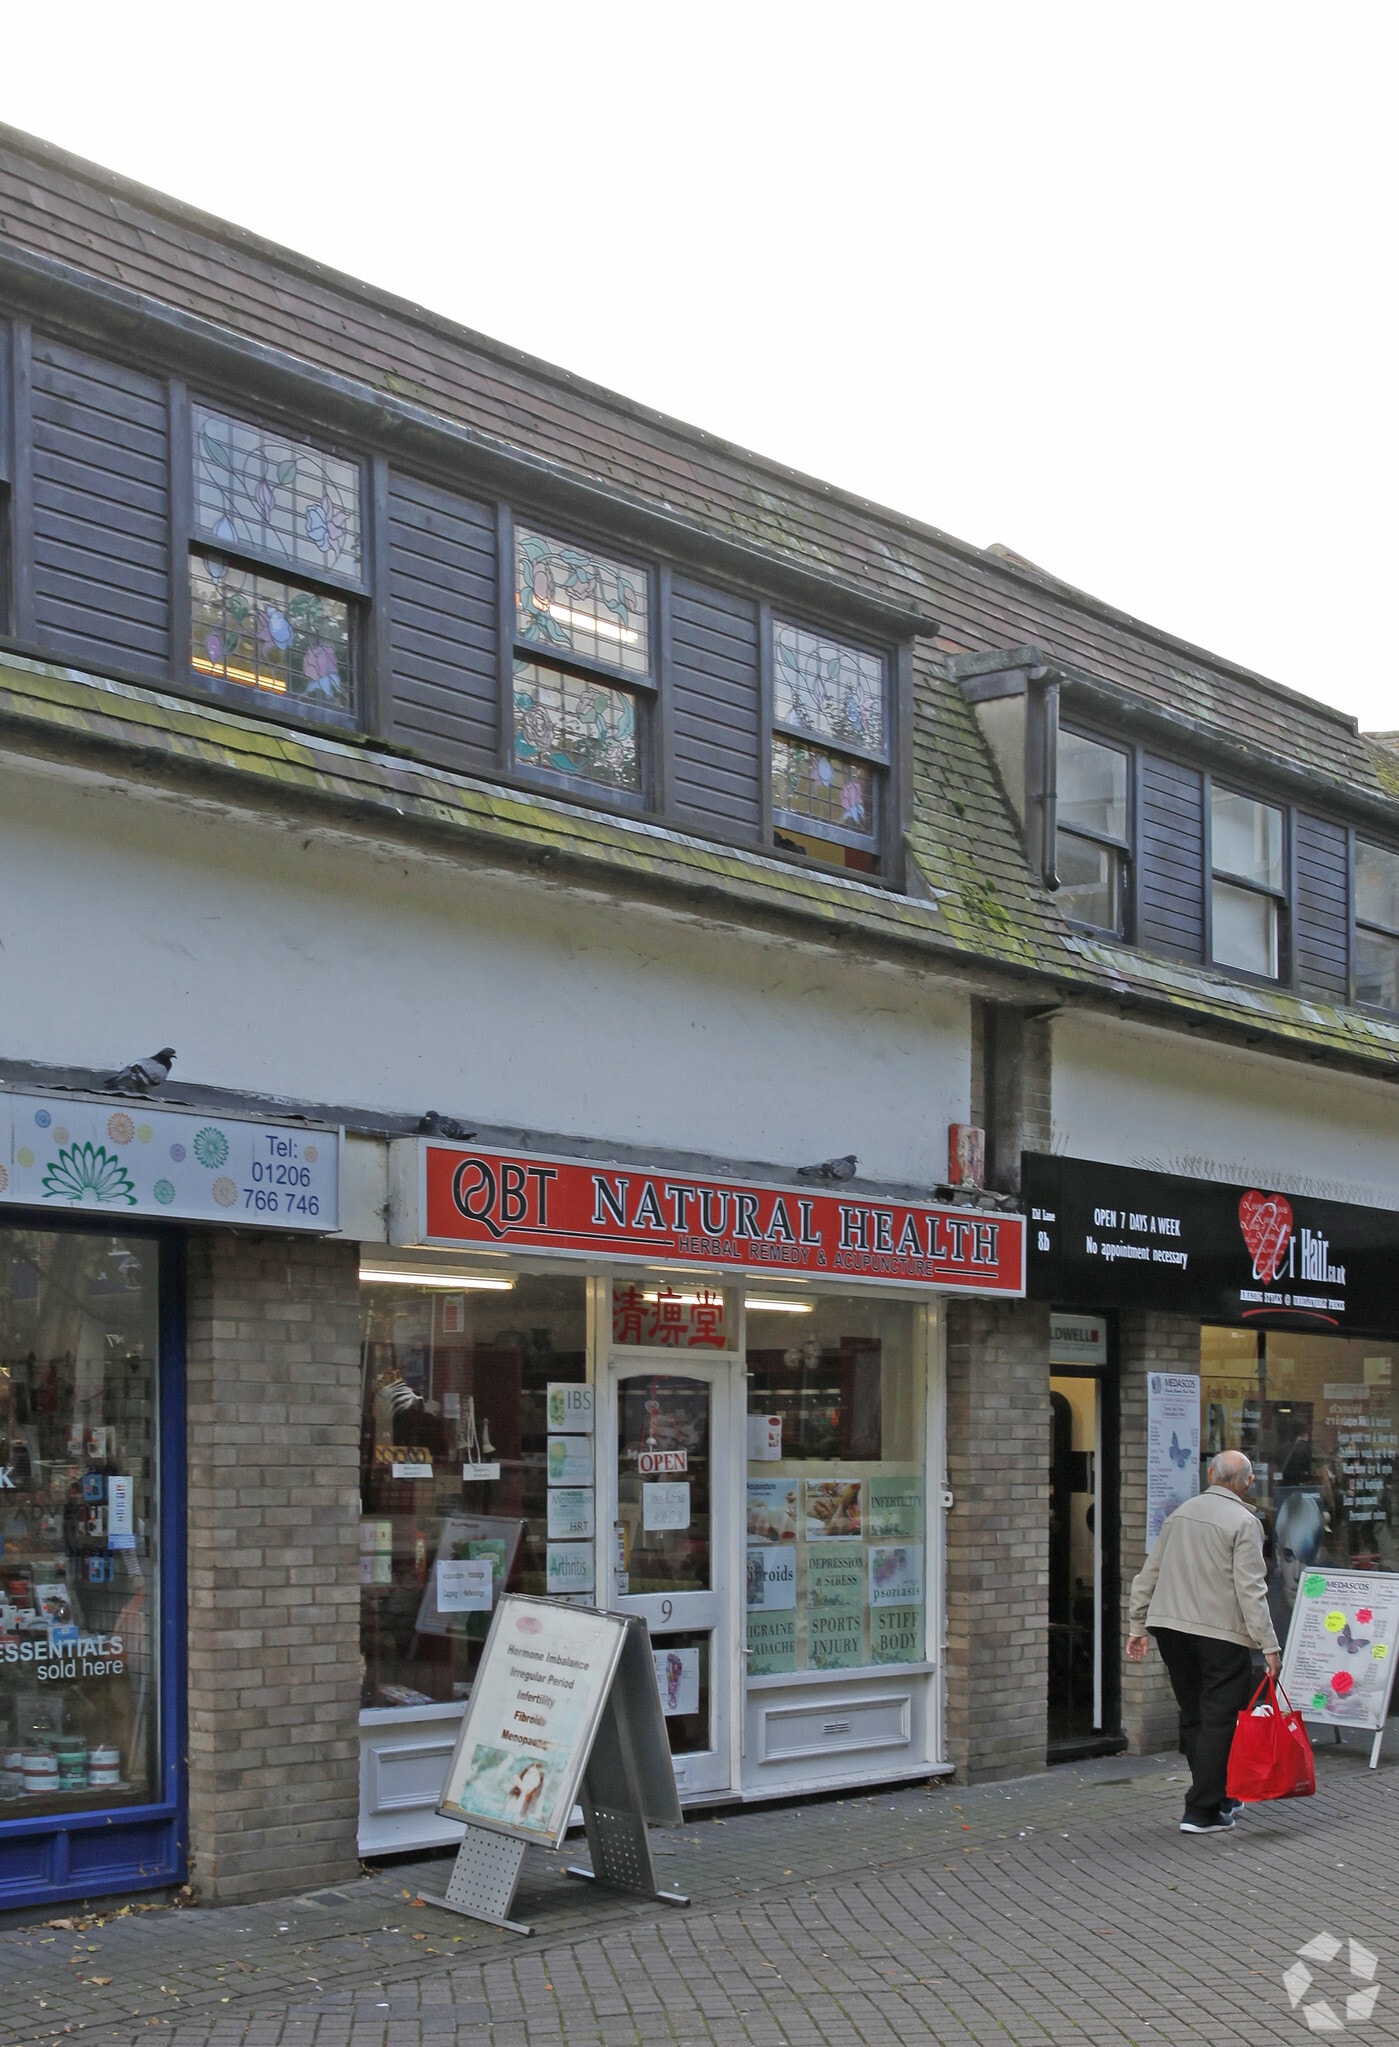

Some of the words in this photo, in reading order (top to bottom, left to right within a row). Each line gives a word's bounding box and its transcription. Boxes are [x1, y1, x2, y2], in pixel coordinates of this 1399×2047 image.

[265, 1135, 298, 1159] Tel:
[251, 1161, 311, 1188] 01206
[243, 1189, 279, 1212] 766
[285, 1193, 320, 1216] 746
[452, 1157, 558, 1239] QBT
[591, 1174, 823, 1247] NATURAL
[838, 1205, 1000, 1267] HEALTH
[1094, 1207, 1117, 1228] OPEN
[1120, 1211, 1126, 1230] 7
[1129, 1212, 1148, 1233] DAYS
[1150, 1215, 1157, 1234] A
[1157, 1216, 1181, 1237] WEEK
[678, 1235, 742, 1259] HERBAL
[750, 1242, 810, 1266] REMEDY
[817, 1249, 827, 1265] &
[833, 1252, 934, 1278] ACUPUNCTURE
[1086, 1235, 1098, 1255] No
[1101, 1240, 1150, 1262] appointment
[1152, 1249, 1188, 1271] necessary
[567, 1390, 591, 1410] IBS
[640, 1453, 686, 1472] OPEN
[570, 1521, 588, 1532] HRT
[550, 1556, 587, 1577] Arthritis
[808, 1557, 864, 1570] DEPRESSION
[815, 1577, 822, 1586] &
[825, 1574, 858, 1587] STRESS
[873, 1585, 921, 1603] psoriasis
[661, 1600, 673, 1624] 9
[878, 1611, 920, 1630] STIFF
[812, 1615, 861, 1634] SPORTS
[747, 1642, 796, 1657] EADACHE
[813, 1637, 860, 1655] INJURY
[880, 1632, 917, 1651] BODY
[507, 1645, 544, 1662] Hormone
[547, 1651, 590, 1670] Imbalance
[37, 1660, 76, 1680] sold
[82, 1659, 124, 1677] here
[510, 1666, 547, 1682] Irregular
[548, 1675, 575, 1689] Period
[517, 1690, 555, 1709] Infertility
